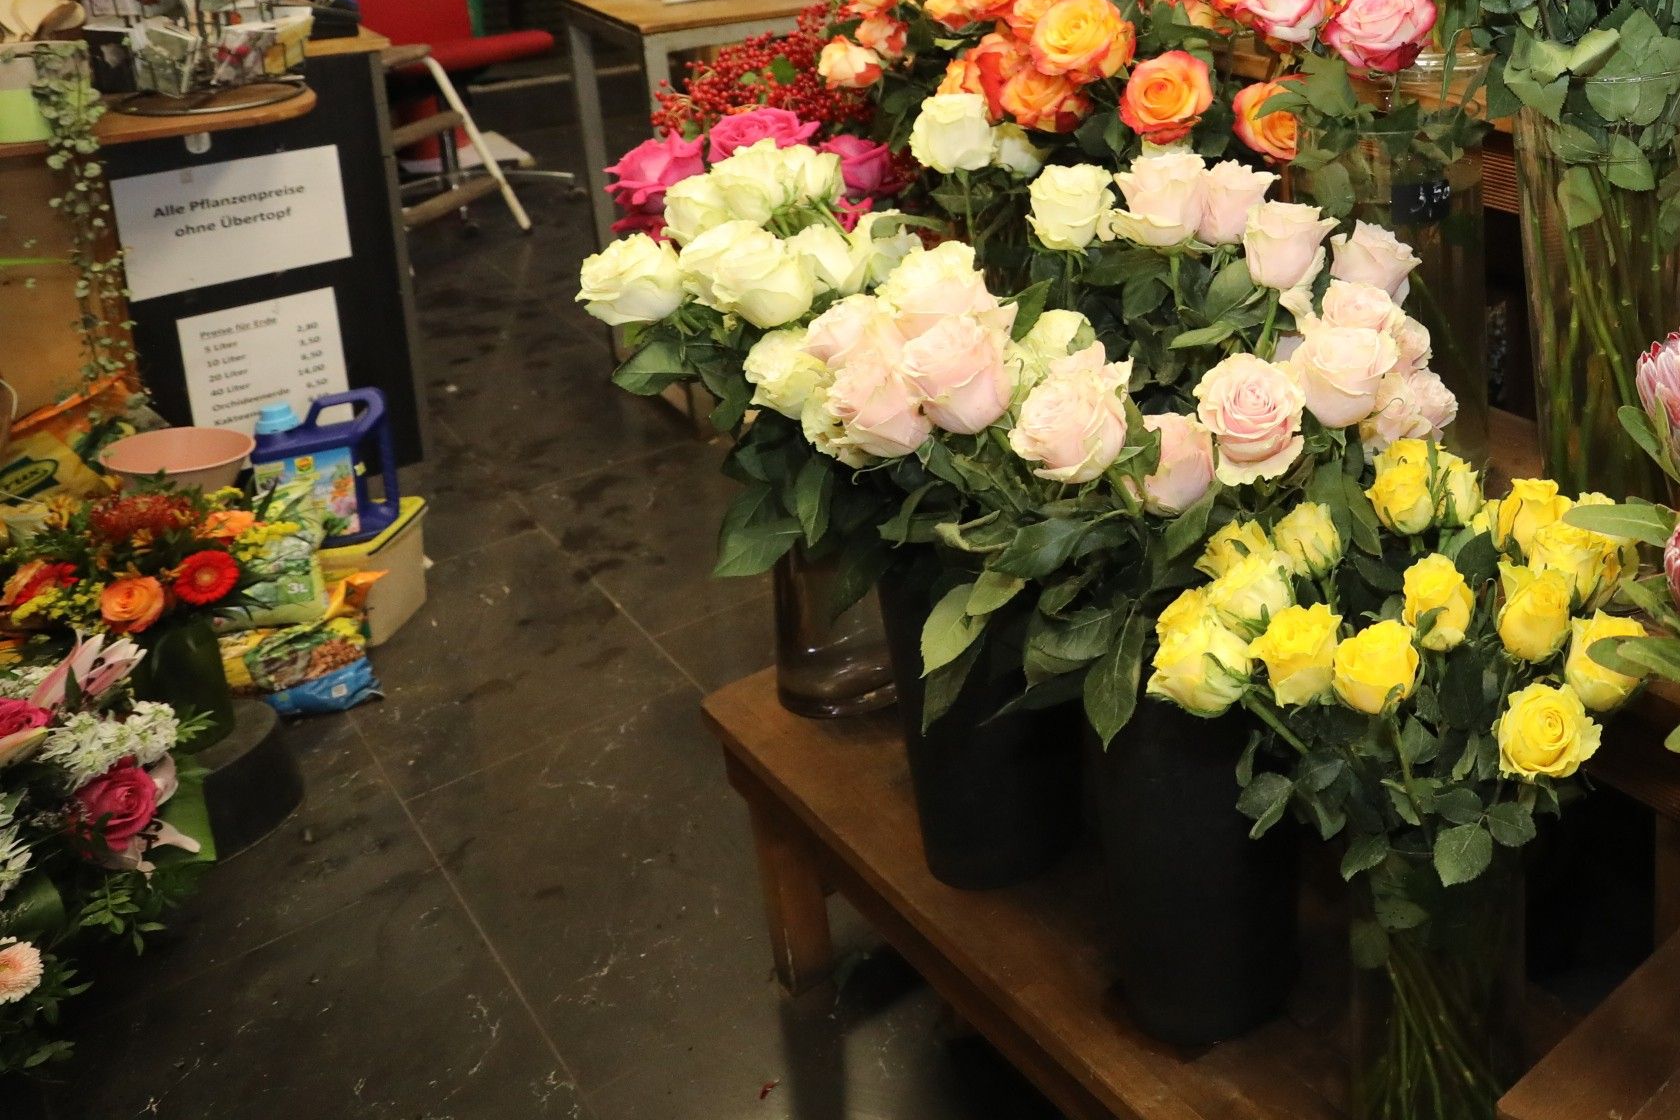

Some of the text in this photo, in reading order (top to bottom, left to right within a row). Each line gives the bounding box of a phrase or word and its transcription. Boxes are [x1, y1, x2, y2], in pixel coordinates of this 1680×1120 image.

[153, 184, 305, 218] Alle Pflanzenpreise
[174, 206, 293, 237] ohne Übertopf
[235, 322, 251, 332] für
[253, 317, 277, 329] Erde
[214, 340, 238, 351] Liter
[207, 359, 220, 368] 10
[222, 354, 247, 365] Liter
[209, 373, 222, 382] 20
[224, 368, 248, 379] Liter
[210, 388, 224, 397] 40
[226, 383, 250, 393] Liter
[213, 388, 289, 411] Orchideenerde
